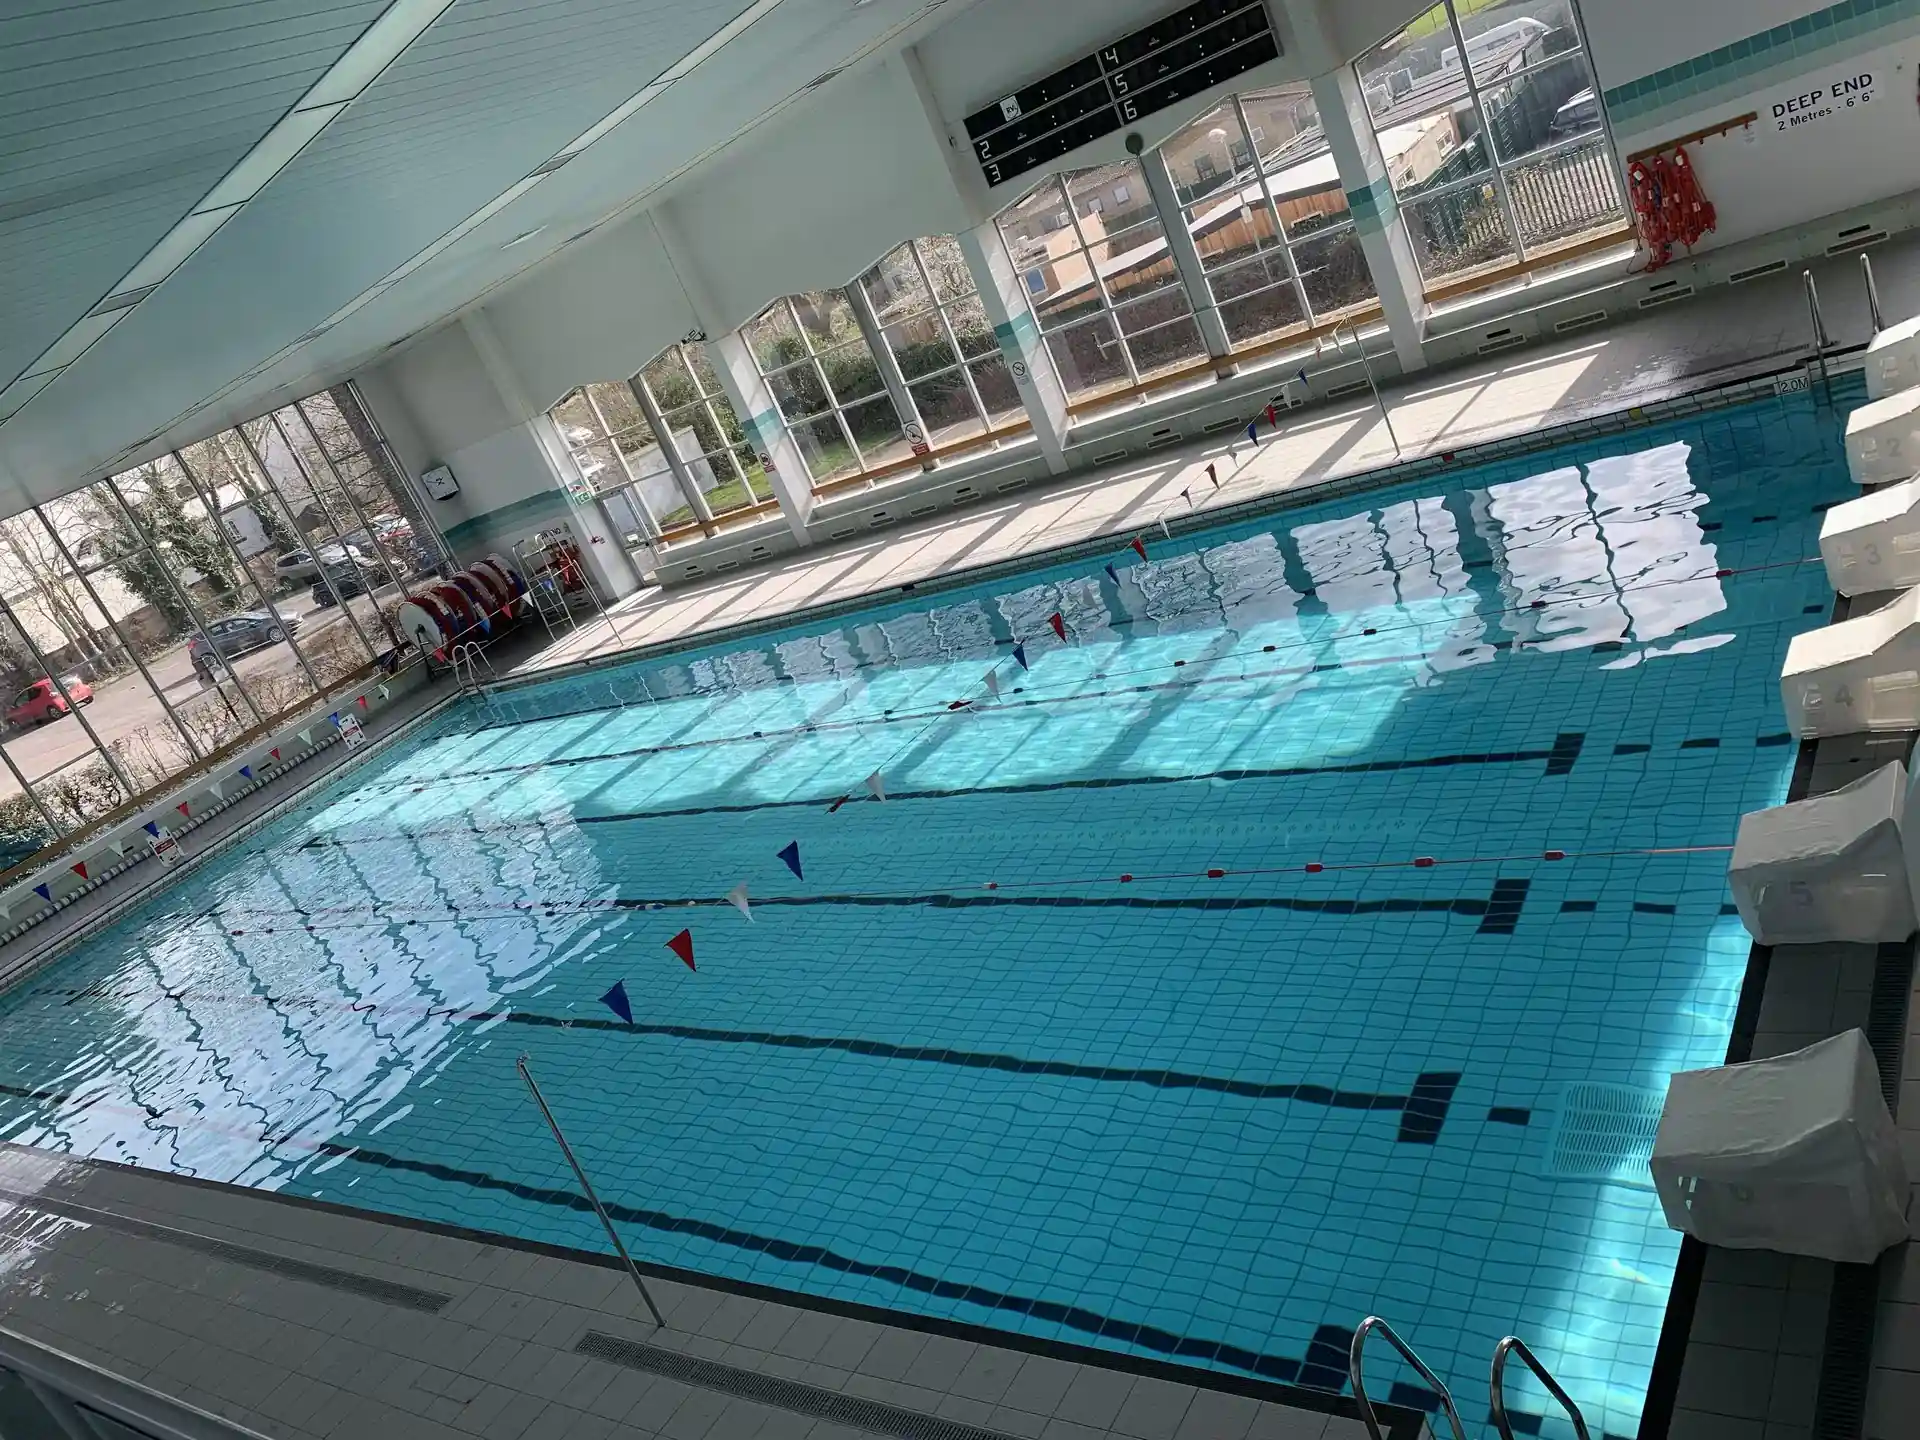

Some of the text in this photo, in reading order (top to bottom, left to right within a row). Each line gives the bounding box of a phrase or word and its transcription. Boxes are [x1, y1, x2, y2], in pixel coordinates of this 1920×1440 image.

[1105, 48, 1119, 64] 4
[1115, 73, 1128, 94] 5
[1772, 73, 1873, 118] DEEP END
[1124, 99, 1137, 120] 6
[1777, 120, 1787, 131] 2
[1790, 106, 1832, 127] Metres
[980, 140, 992, 159] 2
[989, 164, 1001, 182] 3
[1780, 377, 1809, 393] 2.0M
[1886, 437, 1901, 457] 2
[1864, 543, 1882, 566] 3
[1834, 684, 1854, 708] 4
[1790, 880, 1814, 907] 5
